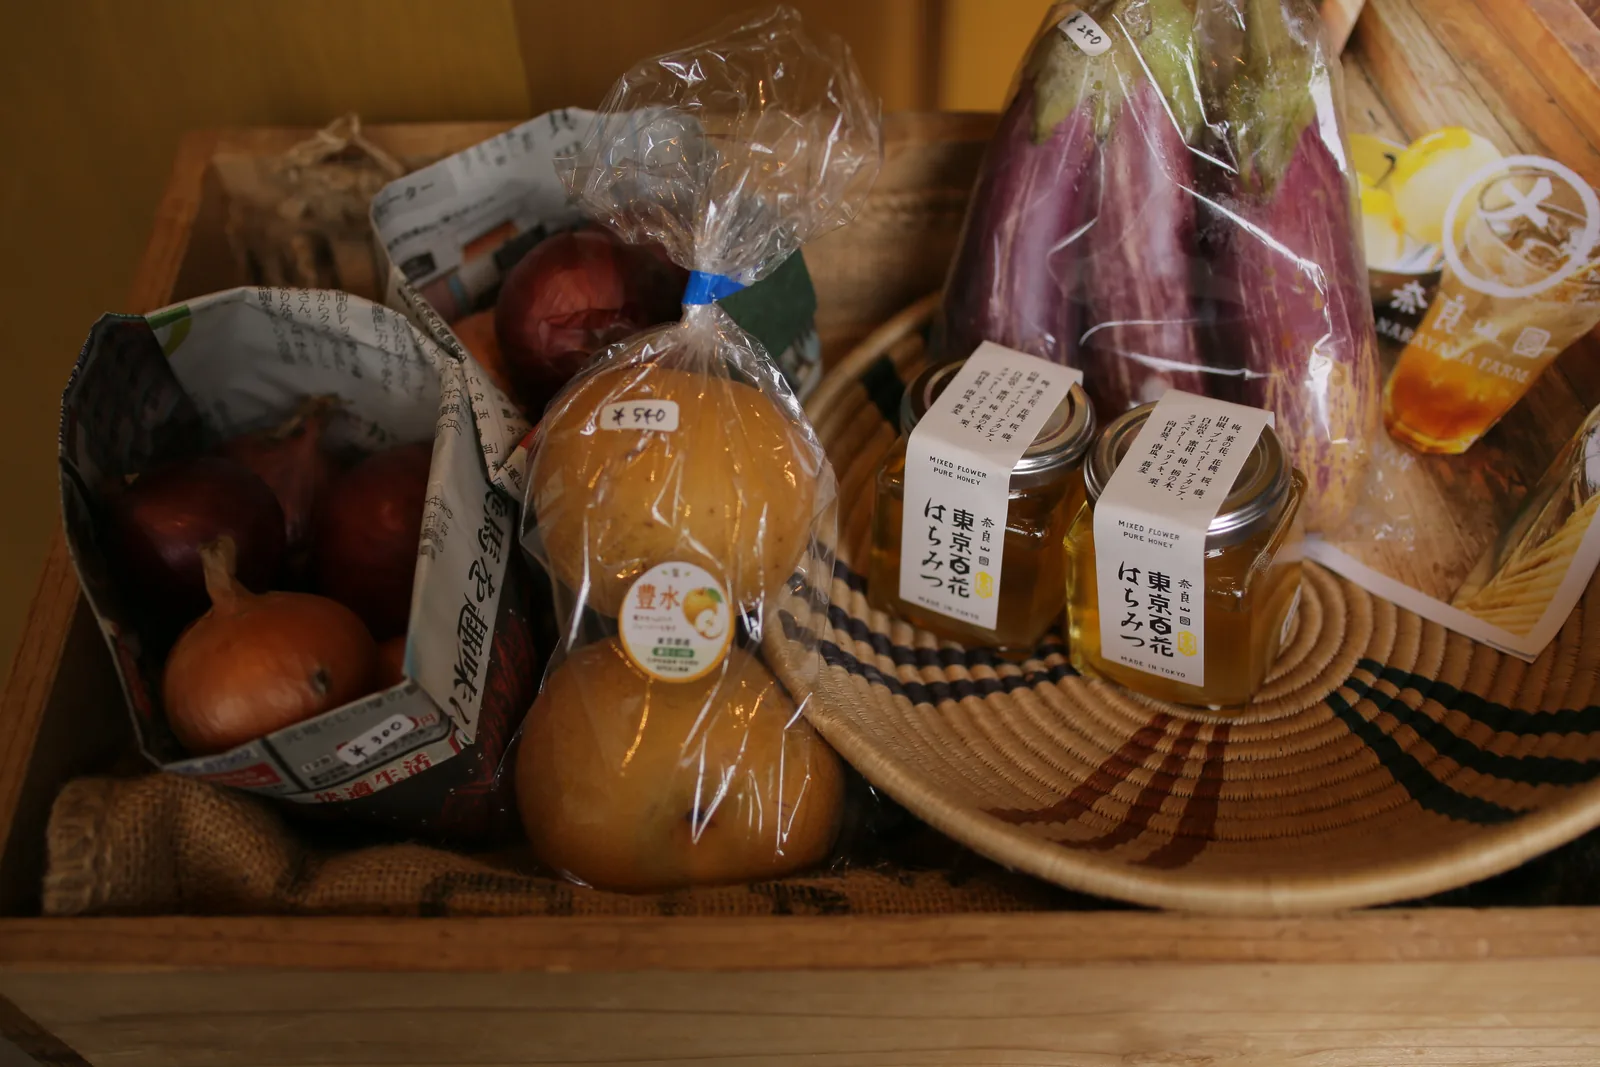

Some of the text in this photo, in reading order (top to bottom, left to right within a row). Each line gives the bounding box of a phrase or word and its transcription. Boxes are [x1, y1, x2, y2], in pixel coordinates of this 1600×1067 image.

[1478, 356, 1530, 384] FARM
[929, 455, 987, 479] MIXED FLOWER
[933, 466, 981, 486] PURE HONEY
[920, 497, 947, 588] はちみつ
[1118, 519, 1180, 541] MIXED FLOWER
[1123, 531, 1174, 549] PURE HONEY
[947, 508, 975, 599] 東京百花
[635, 583, 680, 611] 豊水
[1118, 560, 1146, 648] はちみつ
[1147, 570, 1174, 658] 東京百花
[1120, 655, 1186, 679] MADE IN TOKYO
